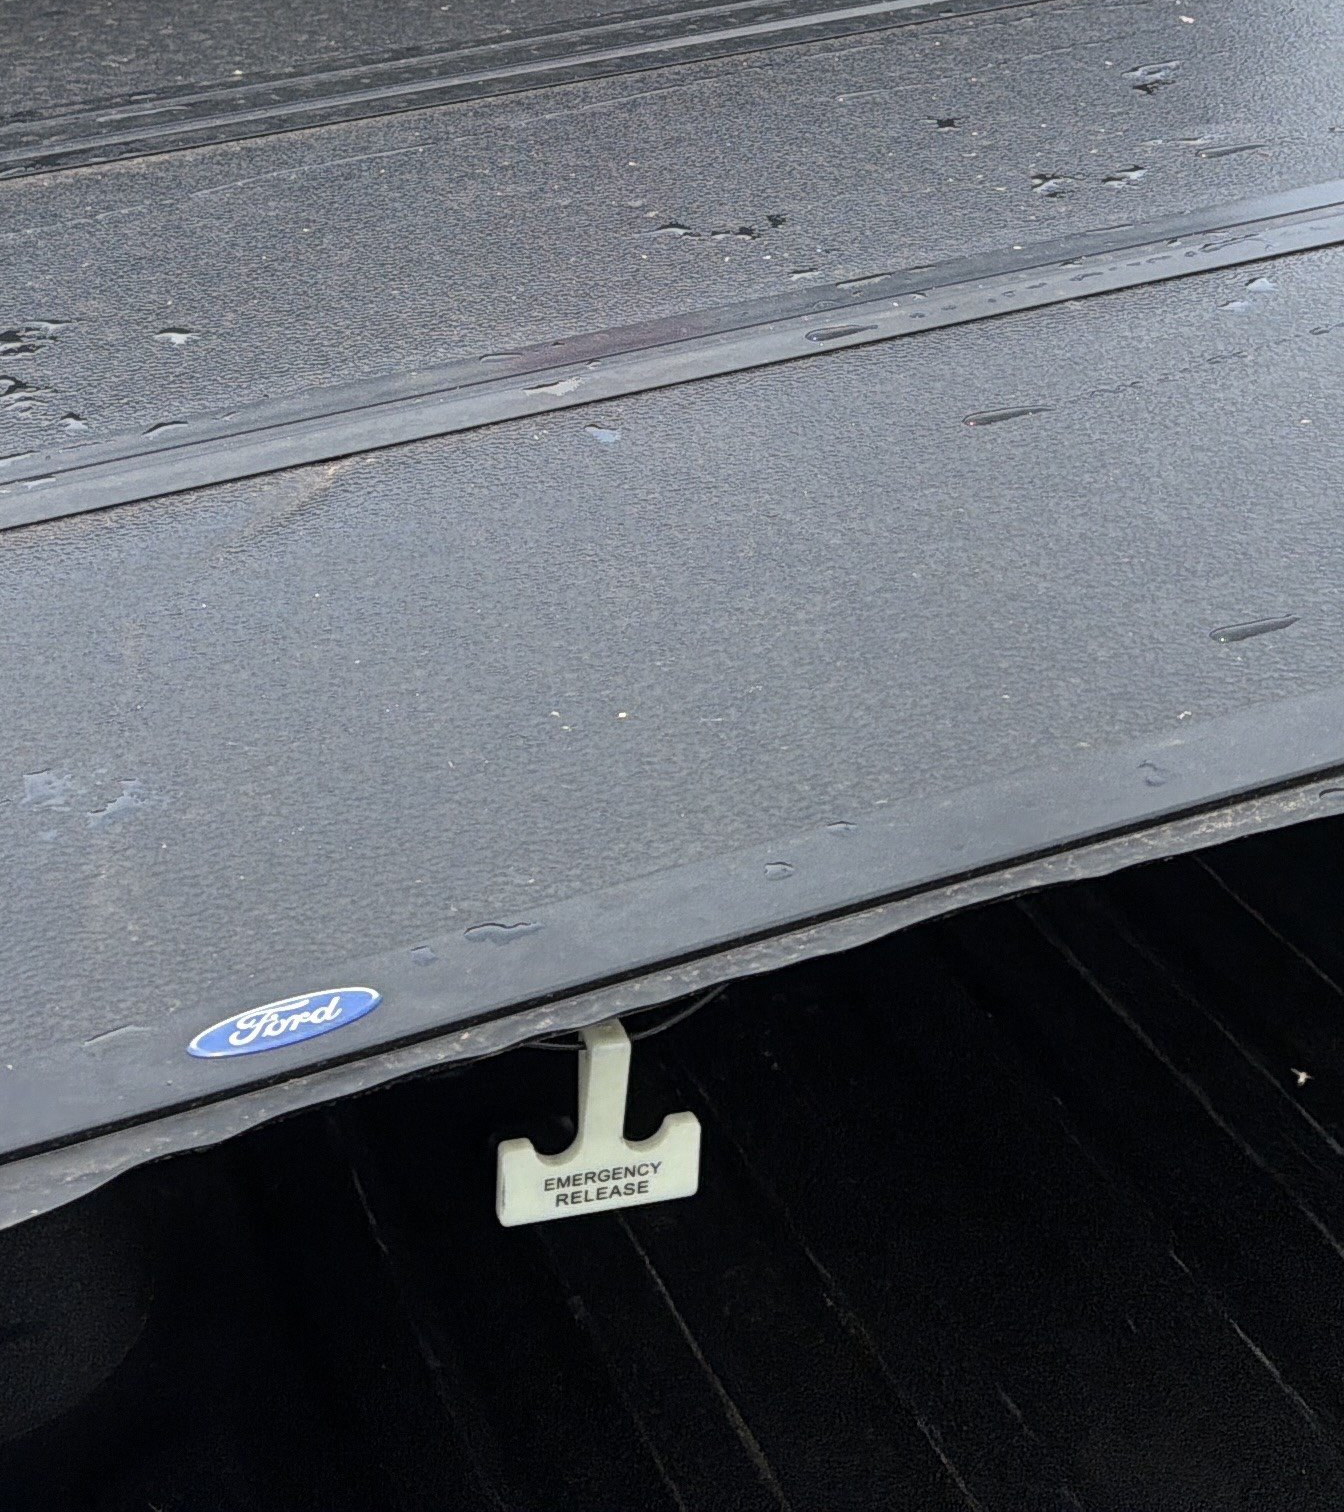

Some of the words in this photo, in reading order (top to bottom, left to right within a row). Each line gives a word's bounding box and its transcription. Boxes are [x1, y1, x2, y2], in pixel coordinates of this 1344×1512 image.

[229, 996, 343, 1046] Ford
[544, 1161, 662, 1192] EMERGENCY
[555, 1180, 650, 1207] RELEASE
